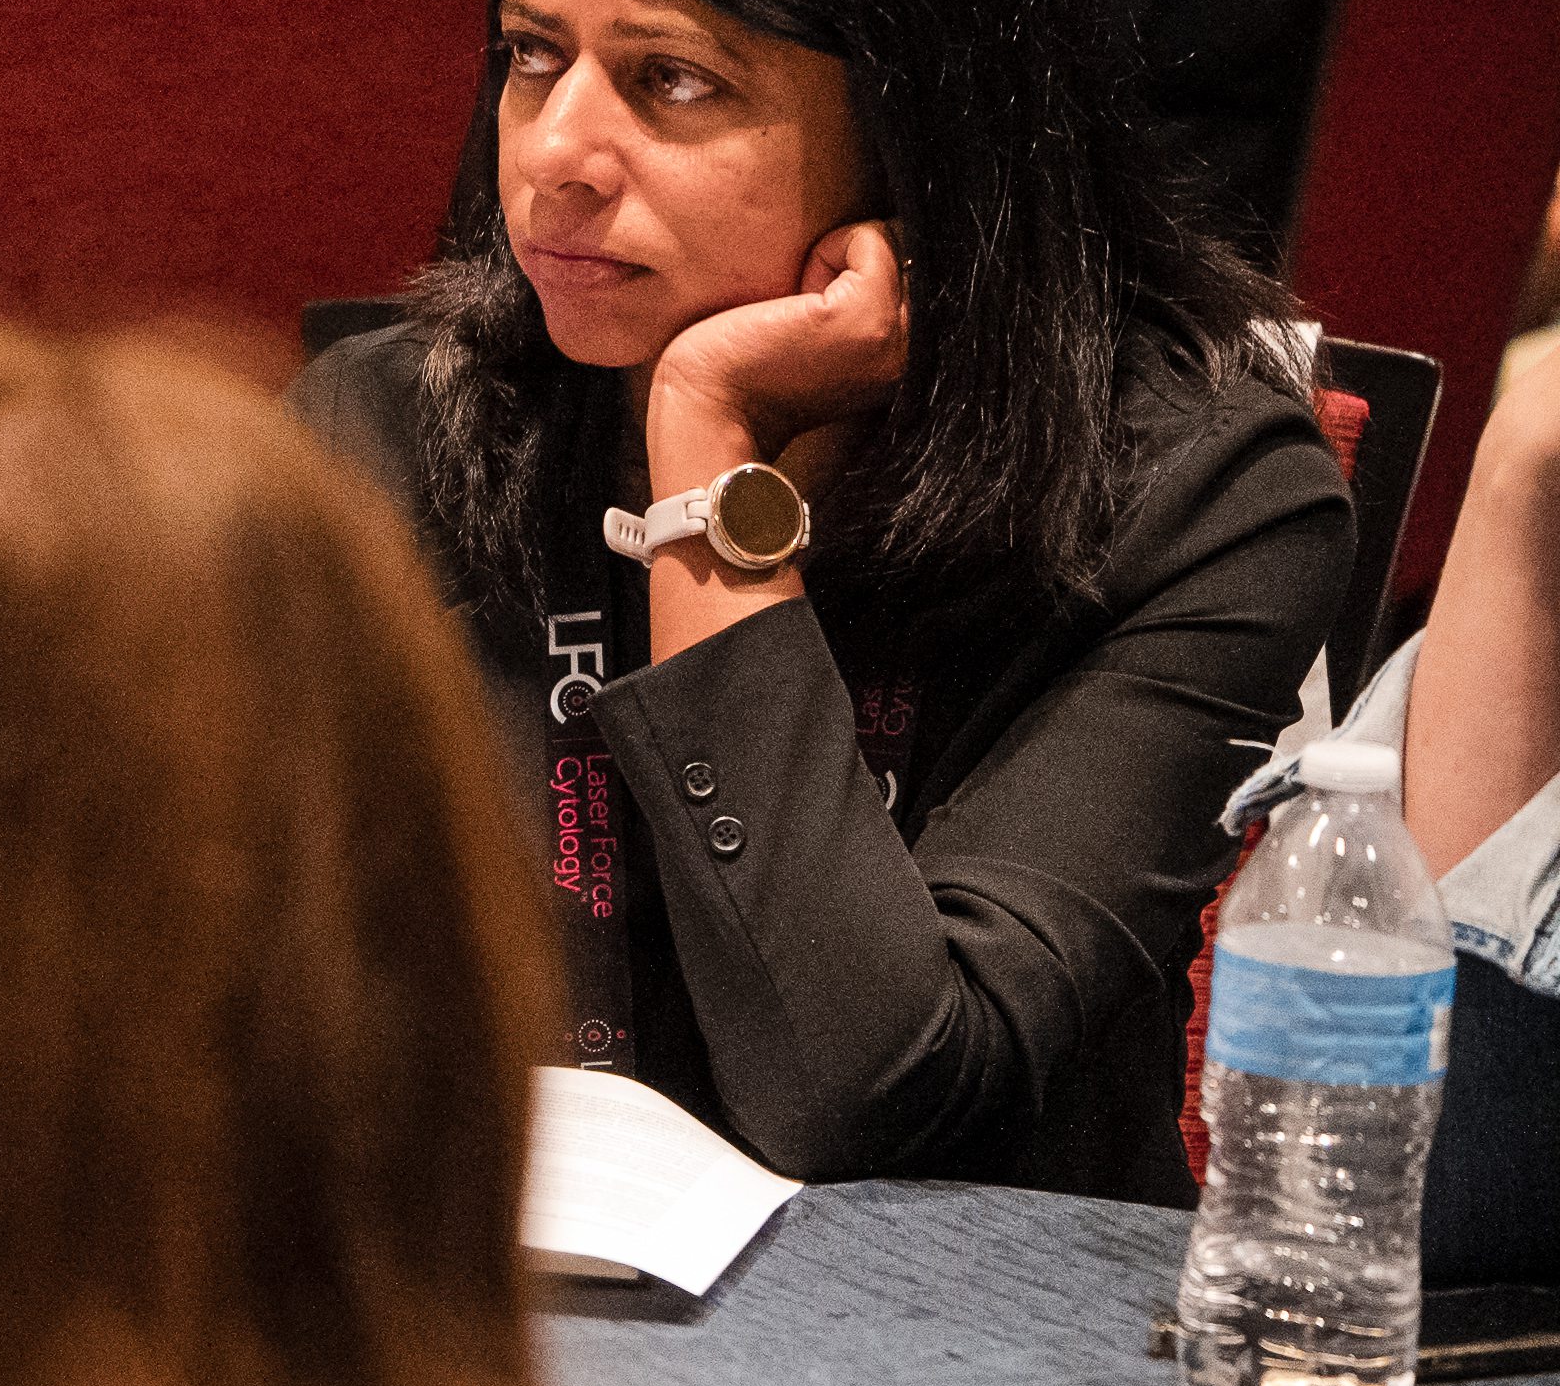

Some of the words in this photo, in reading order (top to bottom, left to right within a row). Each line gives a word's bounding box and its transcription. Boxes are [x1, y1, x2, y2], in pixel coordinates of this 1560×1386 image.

[548, 610, 605, 724] LFC
[586, 754, 612, 830] Laser
[590, 837, 617, 918] Force
